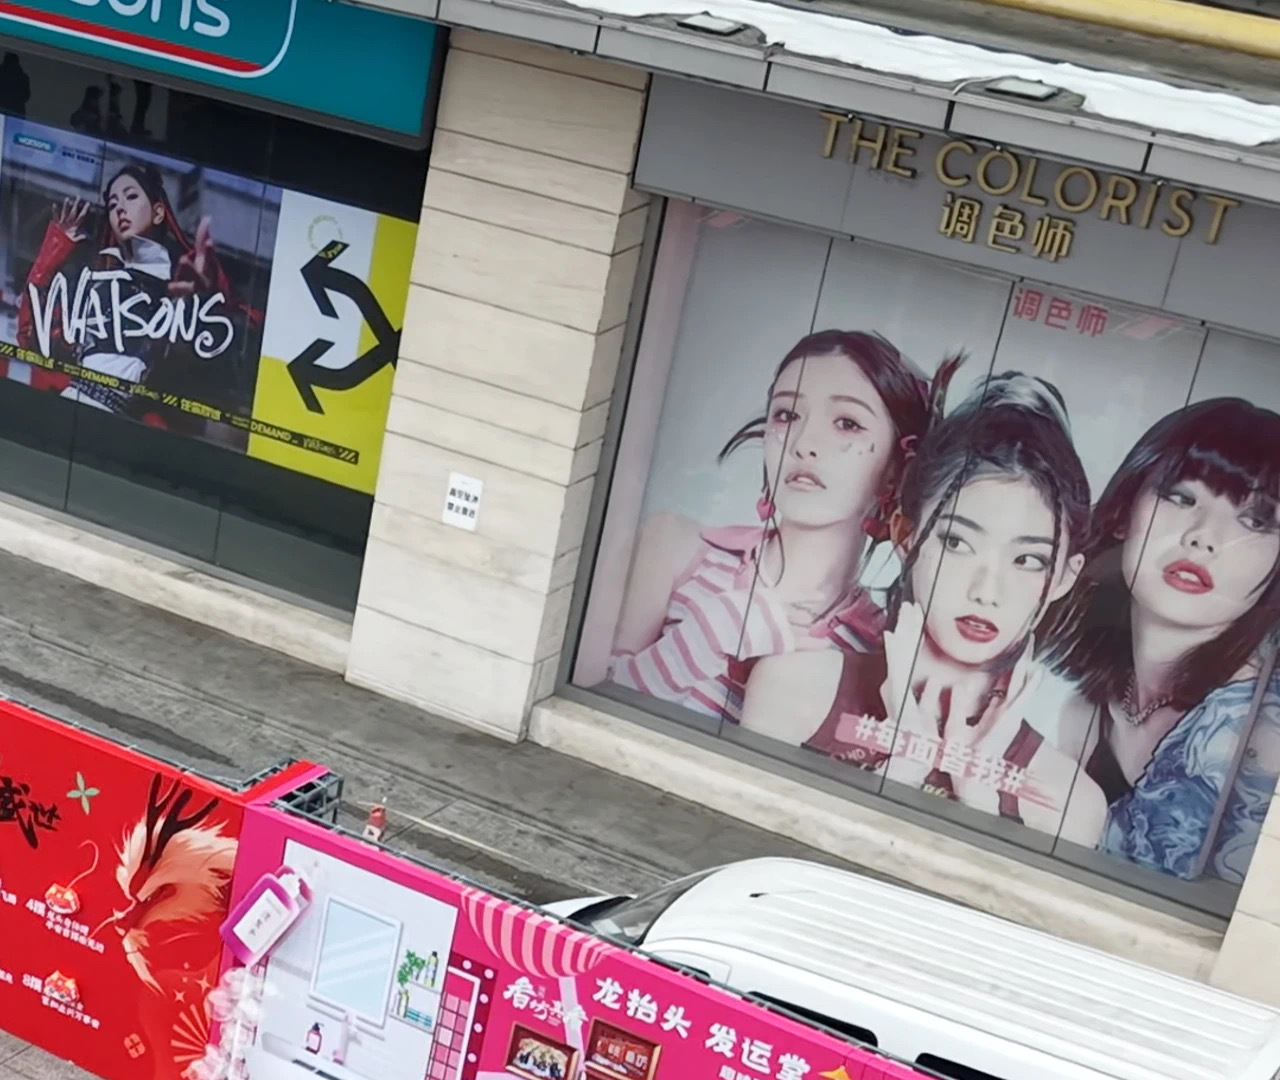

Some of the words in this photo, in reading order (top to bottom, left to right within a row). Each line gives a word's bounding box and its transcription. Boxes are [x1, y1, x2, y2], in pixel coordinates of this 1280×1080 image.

[818, 111, 924, 179] THE
[935, 140, 1240, 246] COLORIST
[939, 193, 1077, 263] 调色师
[1012, 287, 1110, 339] 调色师
[80, 368, 120, 389] DEMAND
[249, 417, 292, 442] DEMAND
[592, 976, 692, 1038] 龙抬头
